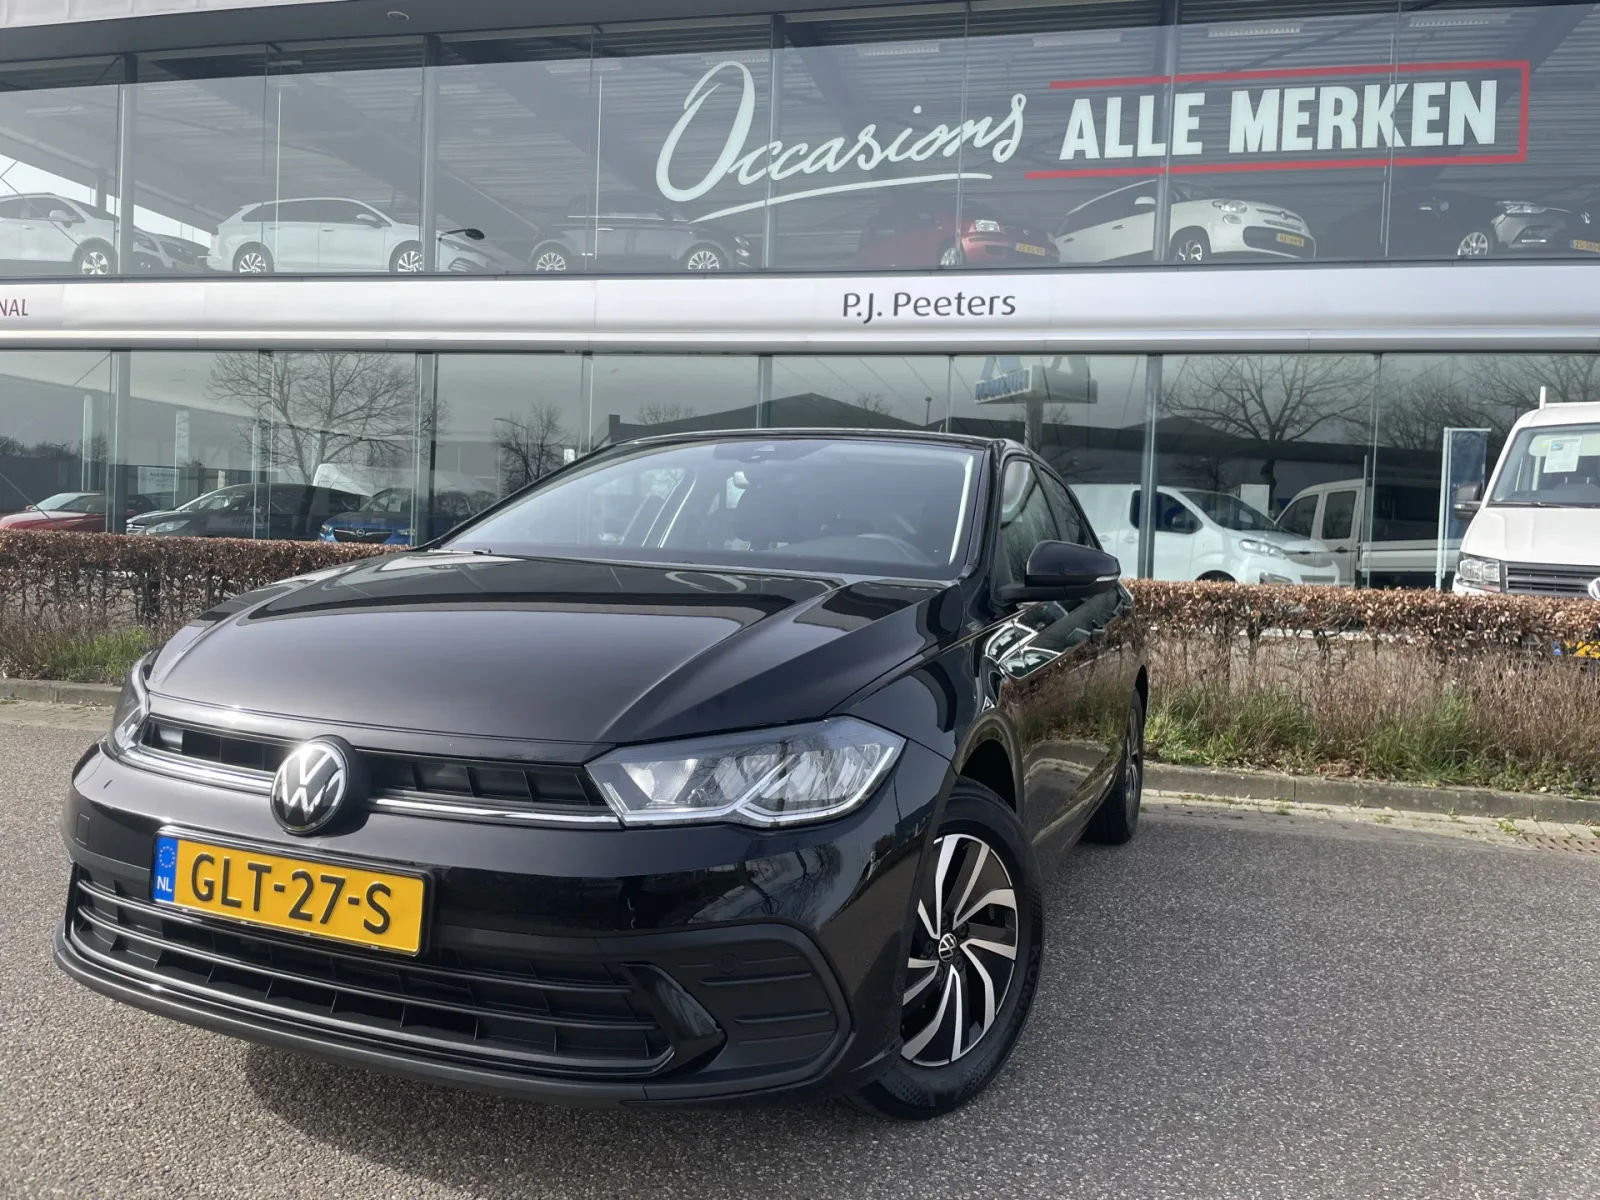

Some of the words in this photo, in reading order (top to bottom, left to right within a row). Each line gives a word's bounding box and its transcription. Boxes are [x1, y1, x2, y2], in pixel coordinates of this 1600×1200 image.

[656, 60, 1028, 202] Occasions
[1059, 92, 1206, 160] ALLE
[1228, 79, 1498, 154] MERKEN
[842, 292, 883, 324] P.J.
[893, 291, 1017, 317] Peeters
[156, 875, 173, 893] NL
[190, 852, 392, 935] GLT-27-S
